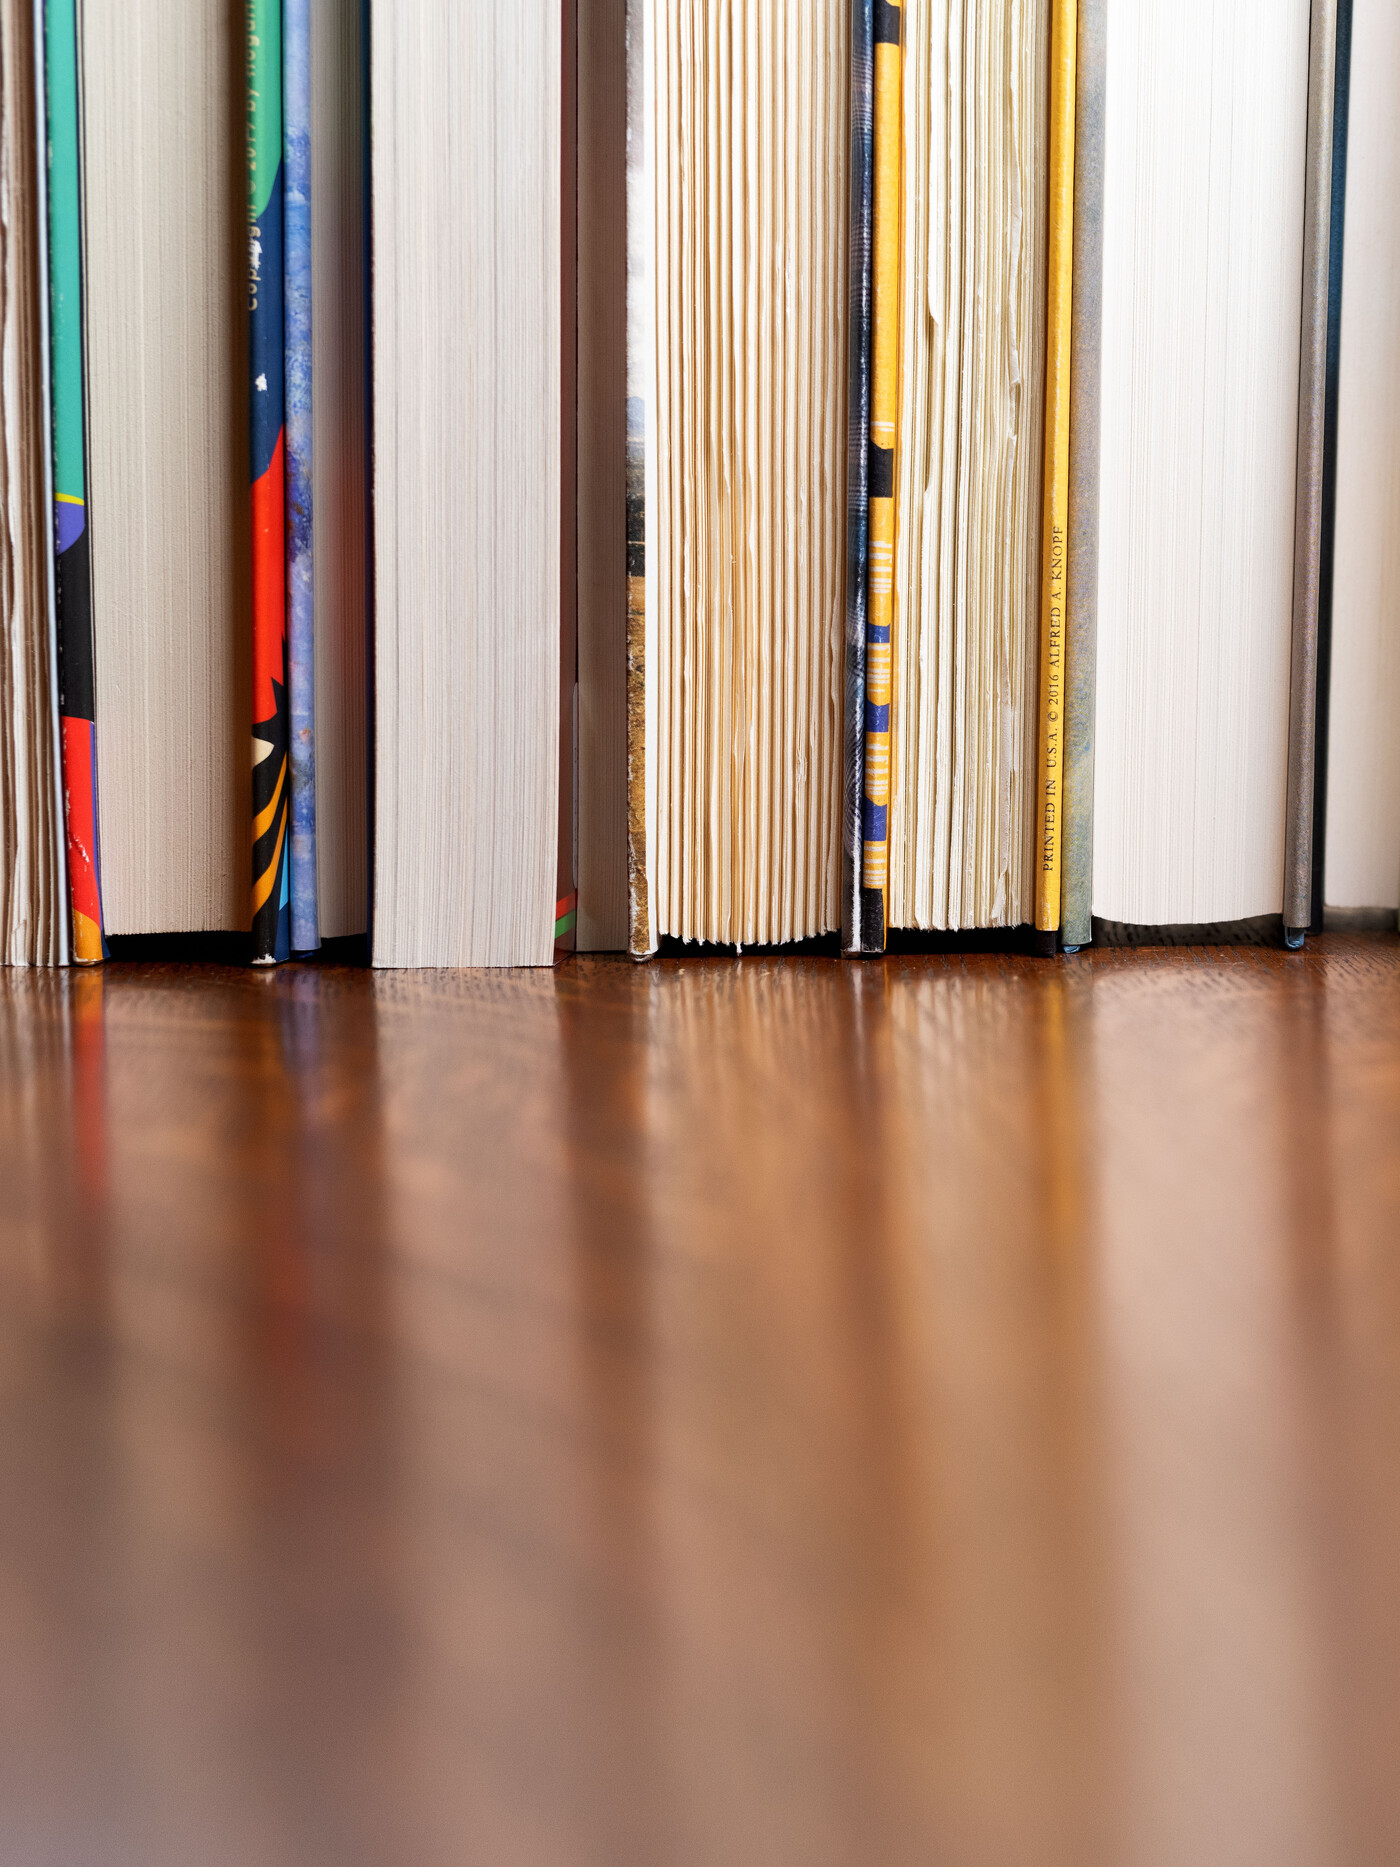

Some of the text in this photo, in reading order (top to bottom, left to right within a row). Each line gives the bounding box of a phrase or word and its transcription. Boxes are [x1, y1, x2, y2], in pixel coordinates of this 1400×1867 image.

[1051, 525, 1063, 581] KNOPF
[1051, 587, 1062, 600] A.
[1049, 606, 1061, 668] ALFRED
[1048, 674, 1060, 706] 2016
[1046, 727, 1058, 769] U.S.A.
[1045, 779, 1057, 796] IN
[1043, 802, 1056, 871] PRINTED
